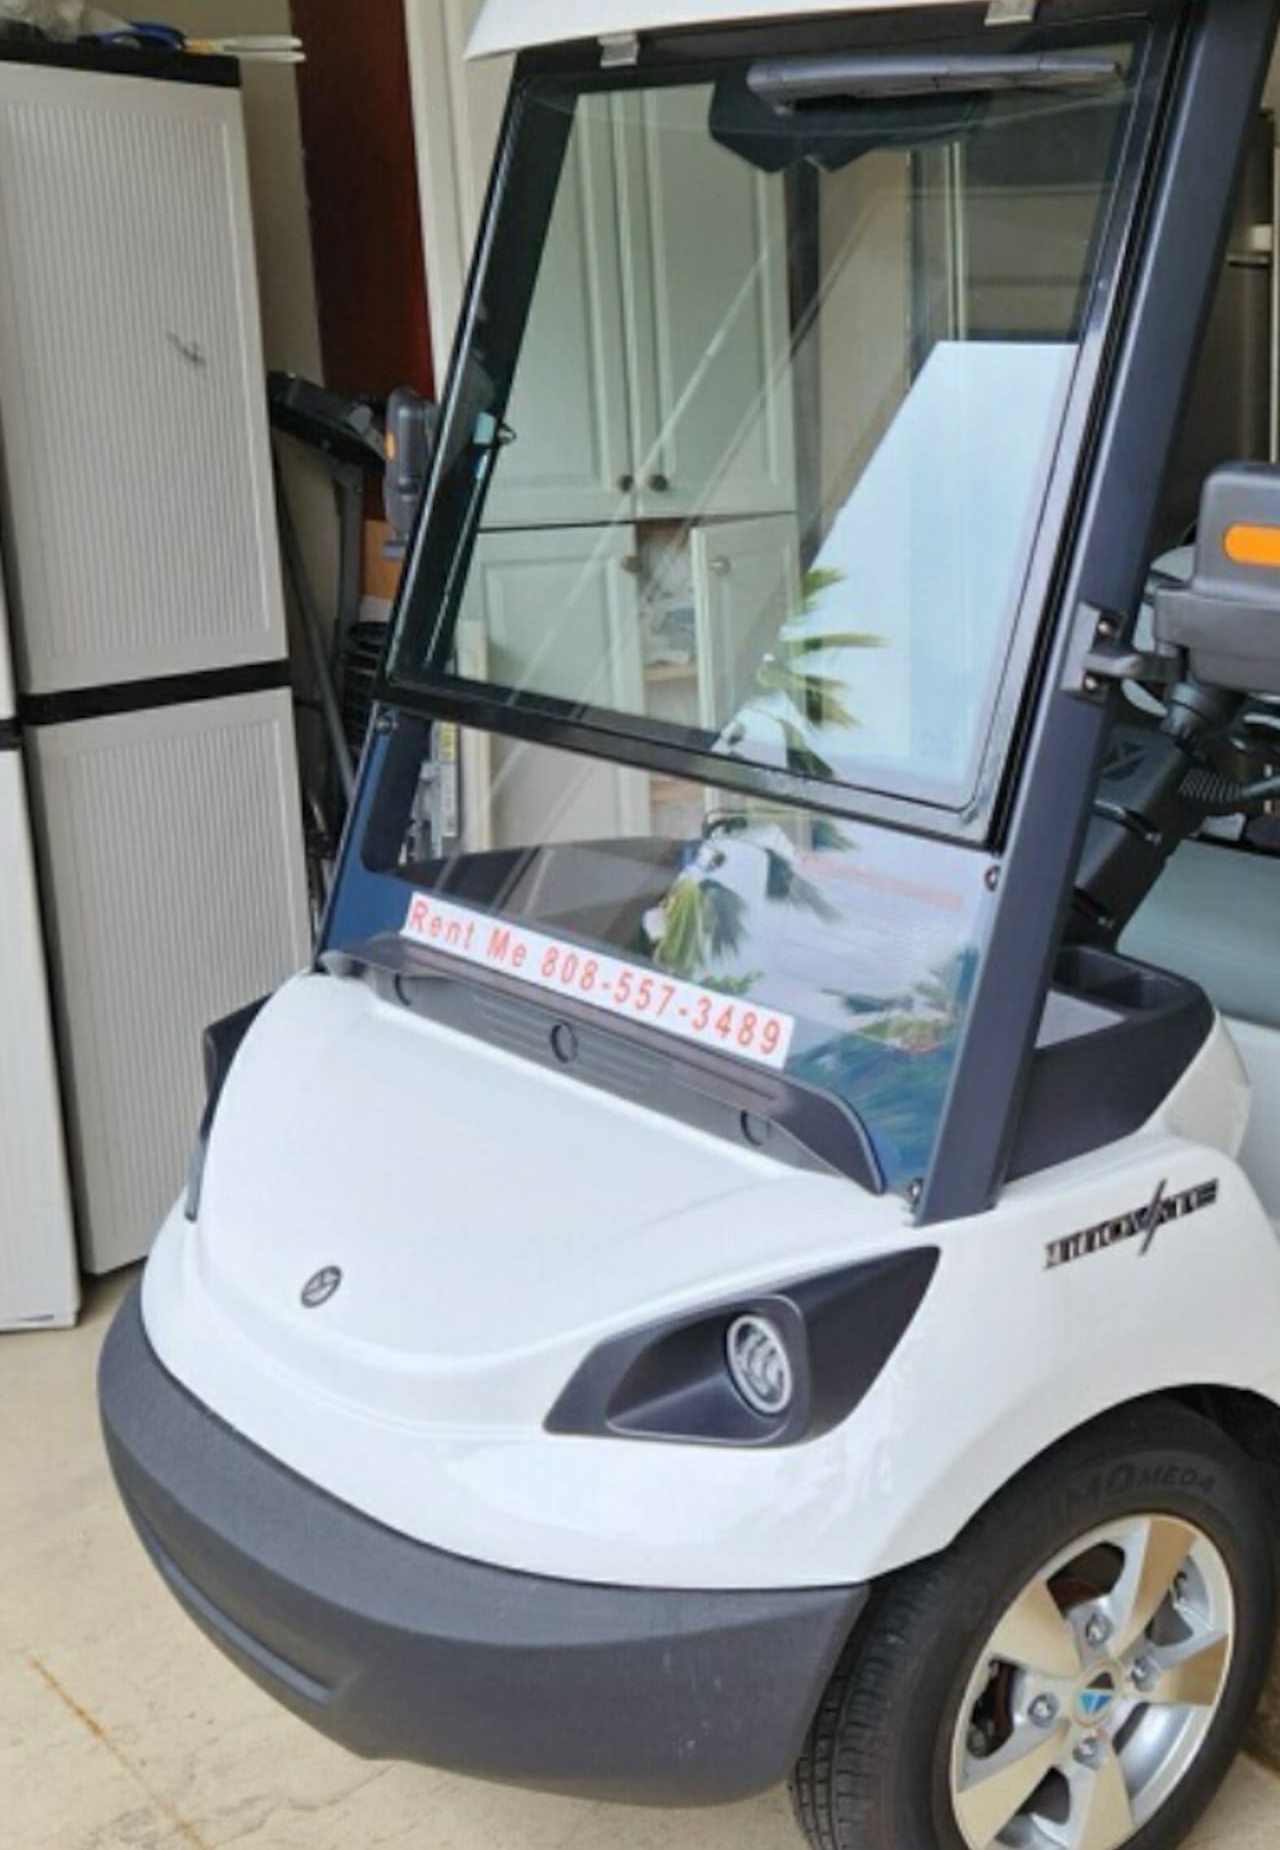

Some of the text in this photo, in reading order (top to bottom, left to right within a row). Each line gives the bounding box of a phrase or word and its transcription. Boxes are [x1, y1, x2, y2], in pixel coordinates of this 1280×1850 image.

[407, 899, 782, 1055] Rent Me 808-557-3489
